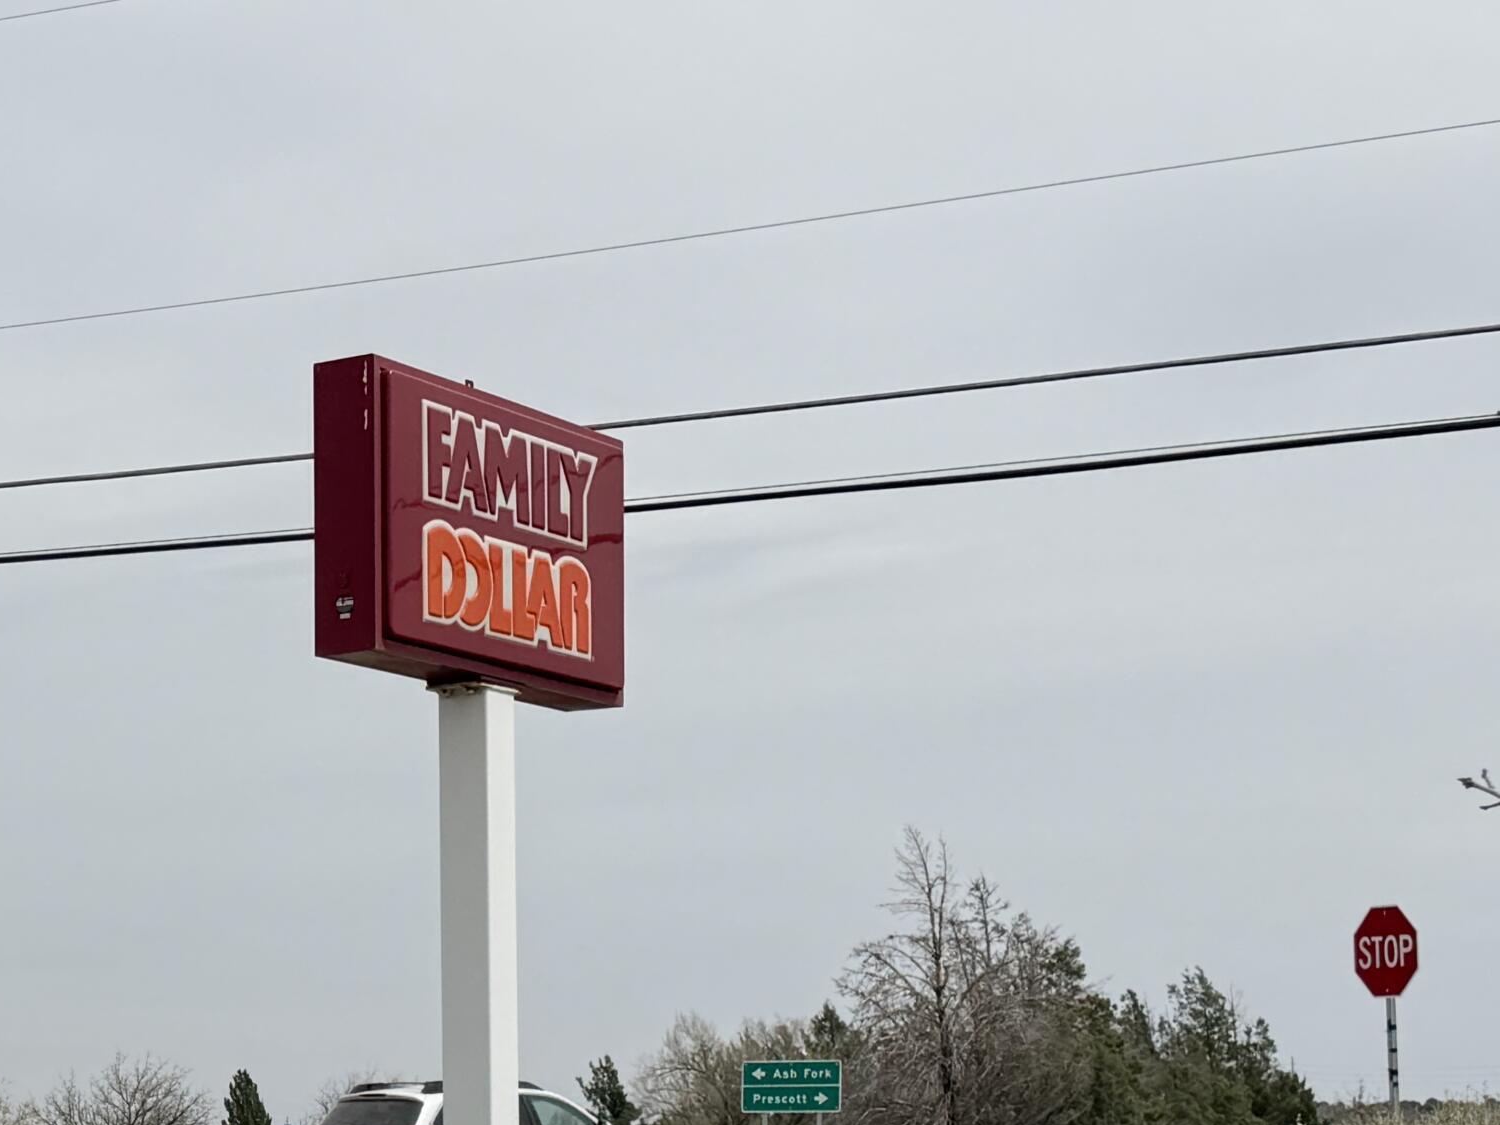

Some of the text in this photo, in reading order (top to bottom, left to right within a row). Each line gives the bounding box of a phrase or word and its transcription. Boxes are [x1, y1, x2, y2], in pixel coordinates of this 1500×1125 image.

[421, 398, 598, 550] FAMILY
[422, 518, 594, 661] DOLLAR
[1358, 933, 1414, 970] STOP
[772, 1067, 832, 1079] Ash Fork
[752, 1093, 808, 1105] Prescott
